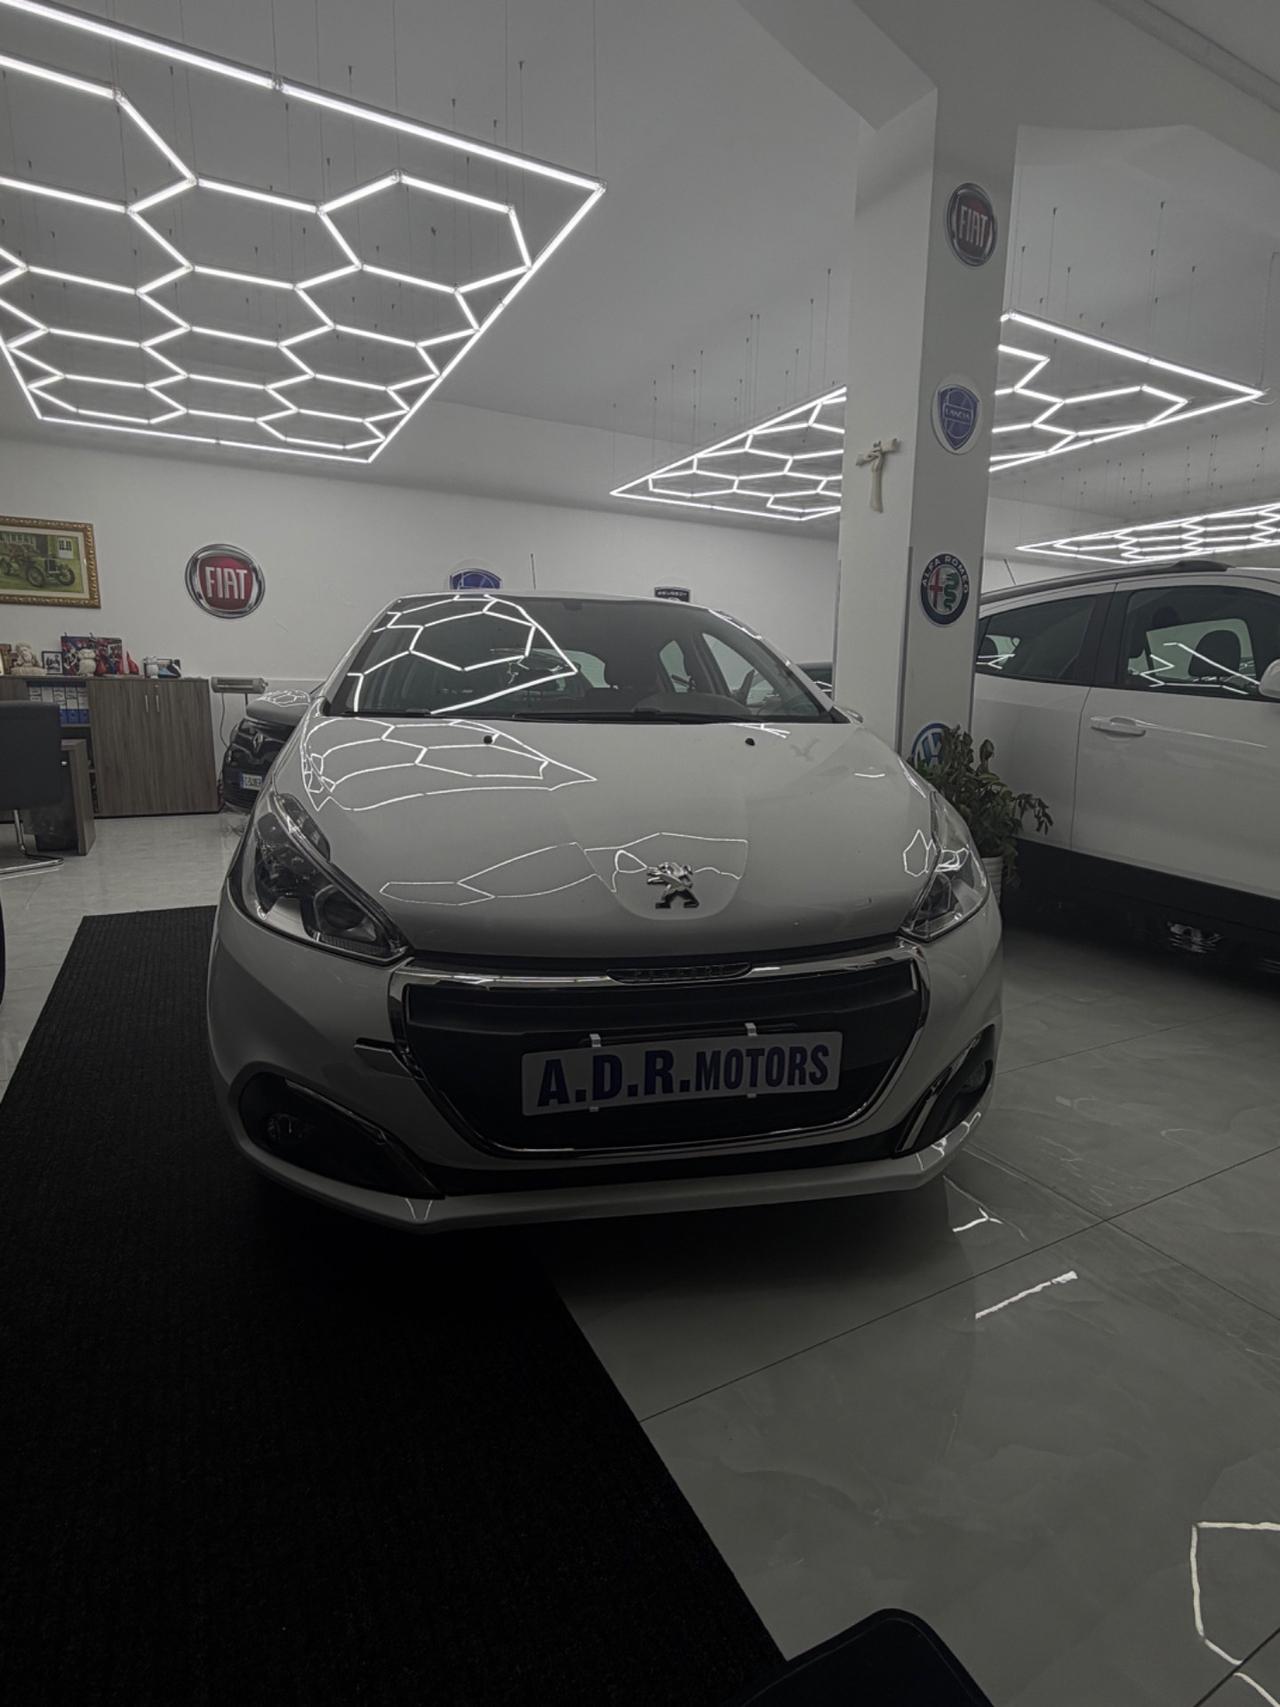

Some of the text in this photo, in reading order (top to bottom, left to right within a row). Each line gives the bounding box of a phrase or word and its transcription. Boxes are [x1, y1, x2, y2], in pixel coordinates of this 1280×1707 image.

[959, 205, 988, 247] FIAT
[205, 566, 248, 600] FIAT
[922, 555, 969, 593] ALFA ROMEO
